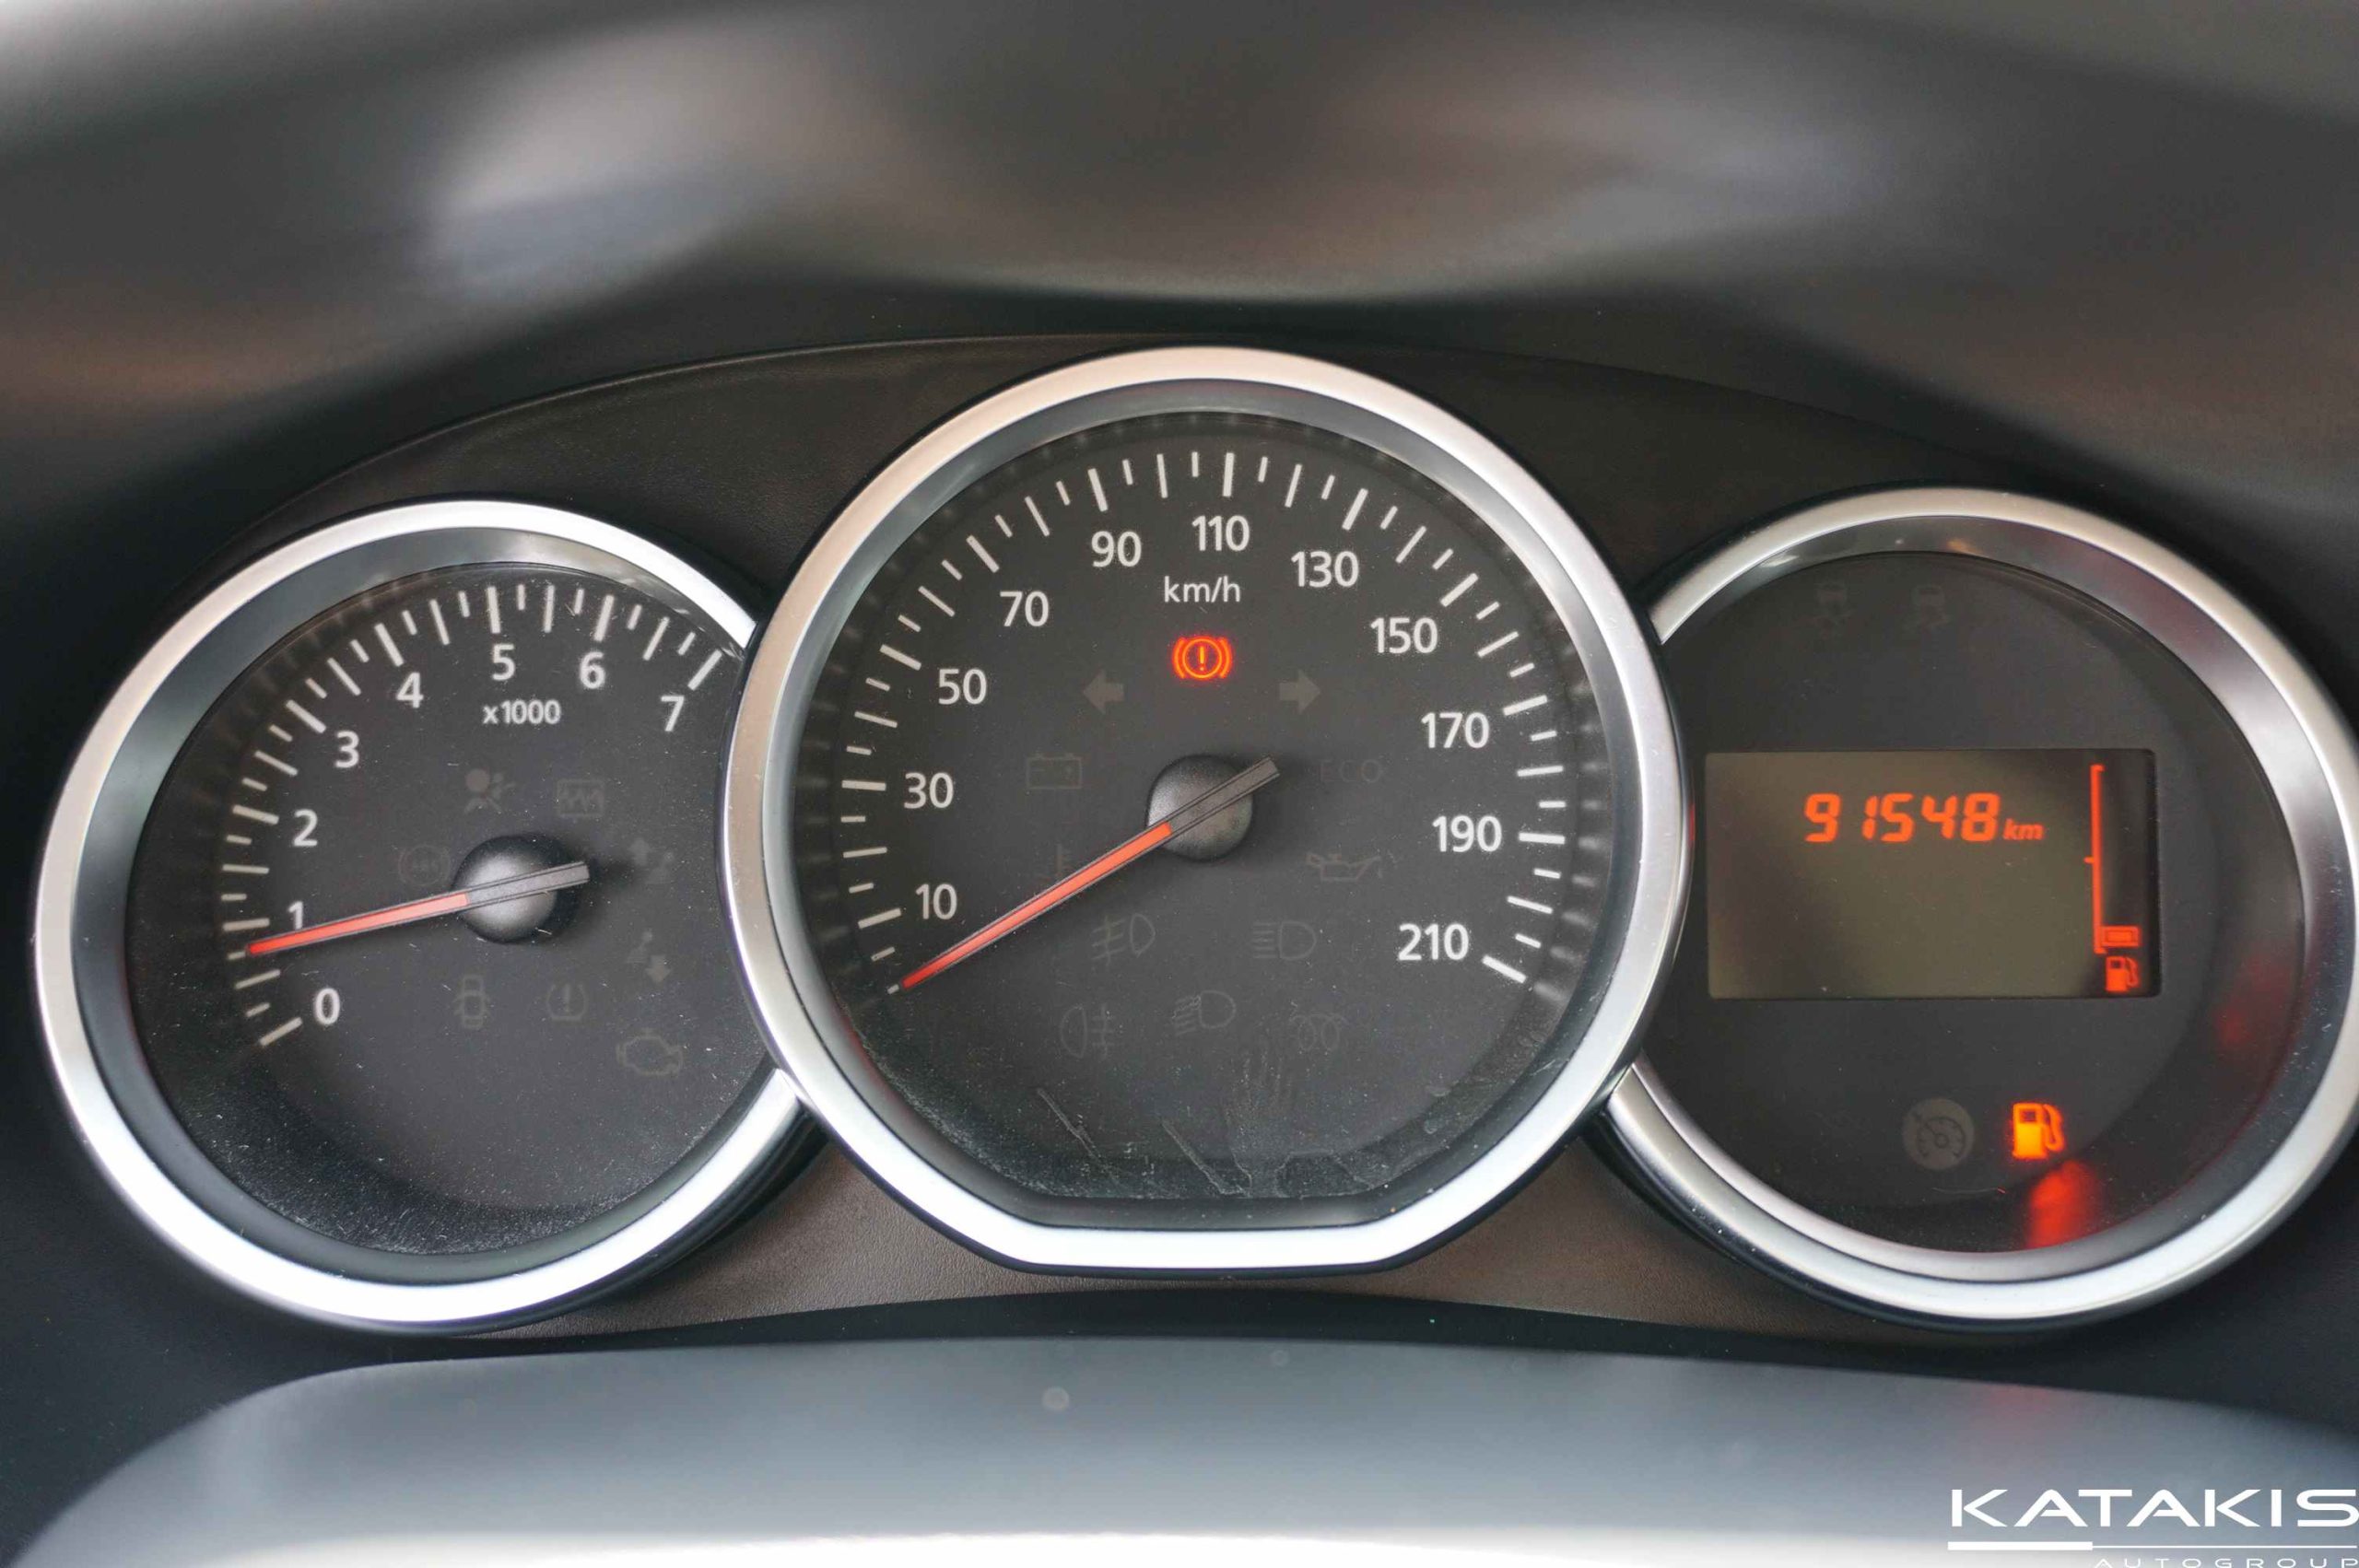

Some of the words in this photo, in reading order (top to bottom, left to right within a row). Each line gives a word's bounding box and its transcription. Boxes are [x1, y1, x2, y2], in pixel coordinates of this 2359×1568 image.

[1091, 531, 1142, 568] 90
[1191, 515, 1250, 552] 110
[1291, 550, 1359, 588] 130
[1164, 575, 1240, 603] km/h
[1000, 591, 1050, 627] 70
[1370, 617, 1438, 654] 150
[492, 643, 516, 681] 5
[580, 651, 605, 689] 6
[396, 672, 424, 708] 4
[938, 668, 987, 705] 50
[483, 699, 561, 724] x1000
[661, 695, 685, 732] 7
[1421, 711, 1490, 749] 170
[335, 731, 359, 768] 3
[904, 772, 954, 809] 30
[294, 809, 318, 847] 2
[1432, 814, 1502, 853] 190
[1803, 792, 2001, 843] 91548
[2002, 818, 2044, 841] km
[288, 901, 304, 929] 1
[915, 883, 957, 919] 10
[1398, 923, 1469, 961] 210
[315, 988, 341, 1025] 0
